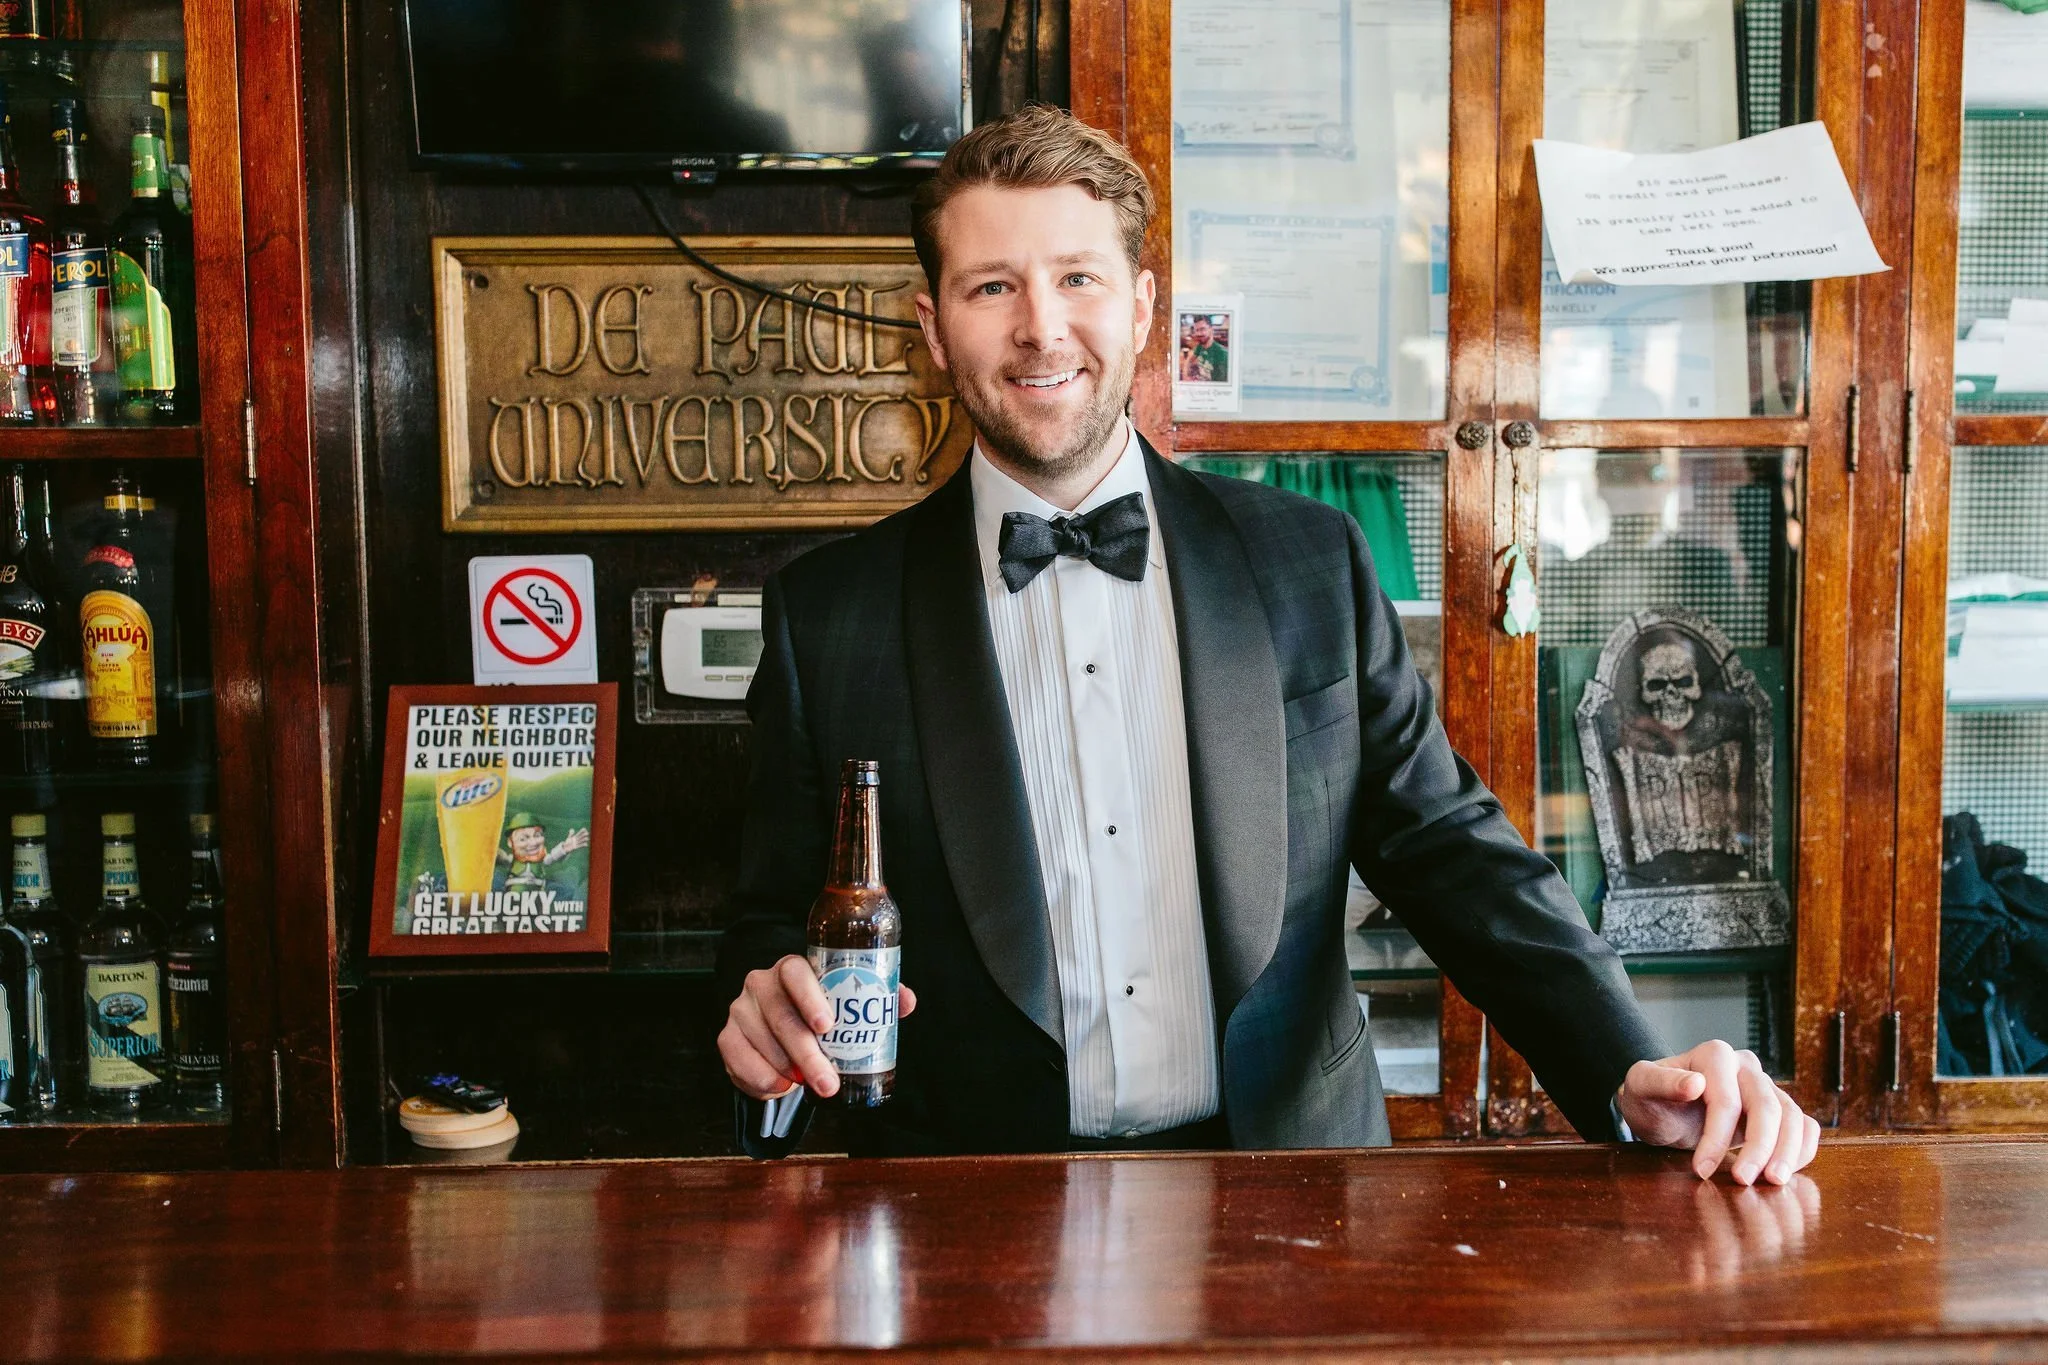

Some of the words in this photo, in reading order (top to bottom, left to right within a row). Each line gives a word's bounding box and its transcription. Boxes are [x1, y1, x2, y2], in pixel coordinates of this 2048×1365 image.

[671, 158, 716, 166] INSIGNIA
[1668, 173, 1728, 186] minimum
[1608, 191, 1657, 200] credit
[1665, 188, 1699, 198] card
[1608, 214, 1675, 227] gratuity
[1683, 210, 1716, 219] will
[1723, 207, 1743, 216] be
[1749, 200, 1793, 213] added
[1800, 195, 1819, 204] to
[1681, 222, 1713, 232] left
[1665, 245, 1717, 256] Thank
[1721, 241, 1755, 253] you!
[1592, 266, 1617, 275] We
[1620, 259, 1707, 274] appreciate
[1710, 255, 1748, 266] your
[1752, 243, 1839, 263] patronage!
[51, 260, 106, 283] EROL
[1561, 303, 1598, 313] KELLY
[528, 283, 653, 376] DE
[692, 280, 914, 384] PAUL
[489, 393, 955, 490] UNIVERSITY
[0, 688, 33, 697] INAL
[416, 707, 499, 727] PLEASE
[508, 706, 595, 726] RESPEC
[102, 723, 141, 732] ORIGINAL
[416, 729, 463, 748] OUR
[414, 752, 428, 769] &
[438, 751, 504, 769] LEAVE
[451, 781, 495, 807] Lite
[414, 890, 465, 917] GET
[470, 890, 557, 917] LUCKY
[553, 900, 584, 914] WITH
[412, 916, 498, 936] GREAT
[502, 914, 584, 935] TASTE
[98, 971, 145, 983] BARTON
[833, 993, 896, 1026] USCH
[89, 1028, 160, 1059] SUPERIOR
[821, 1029, 880, 1044] LIGHT
